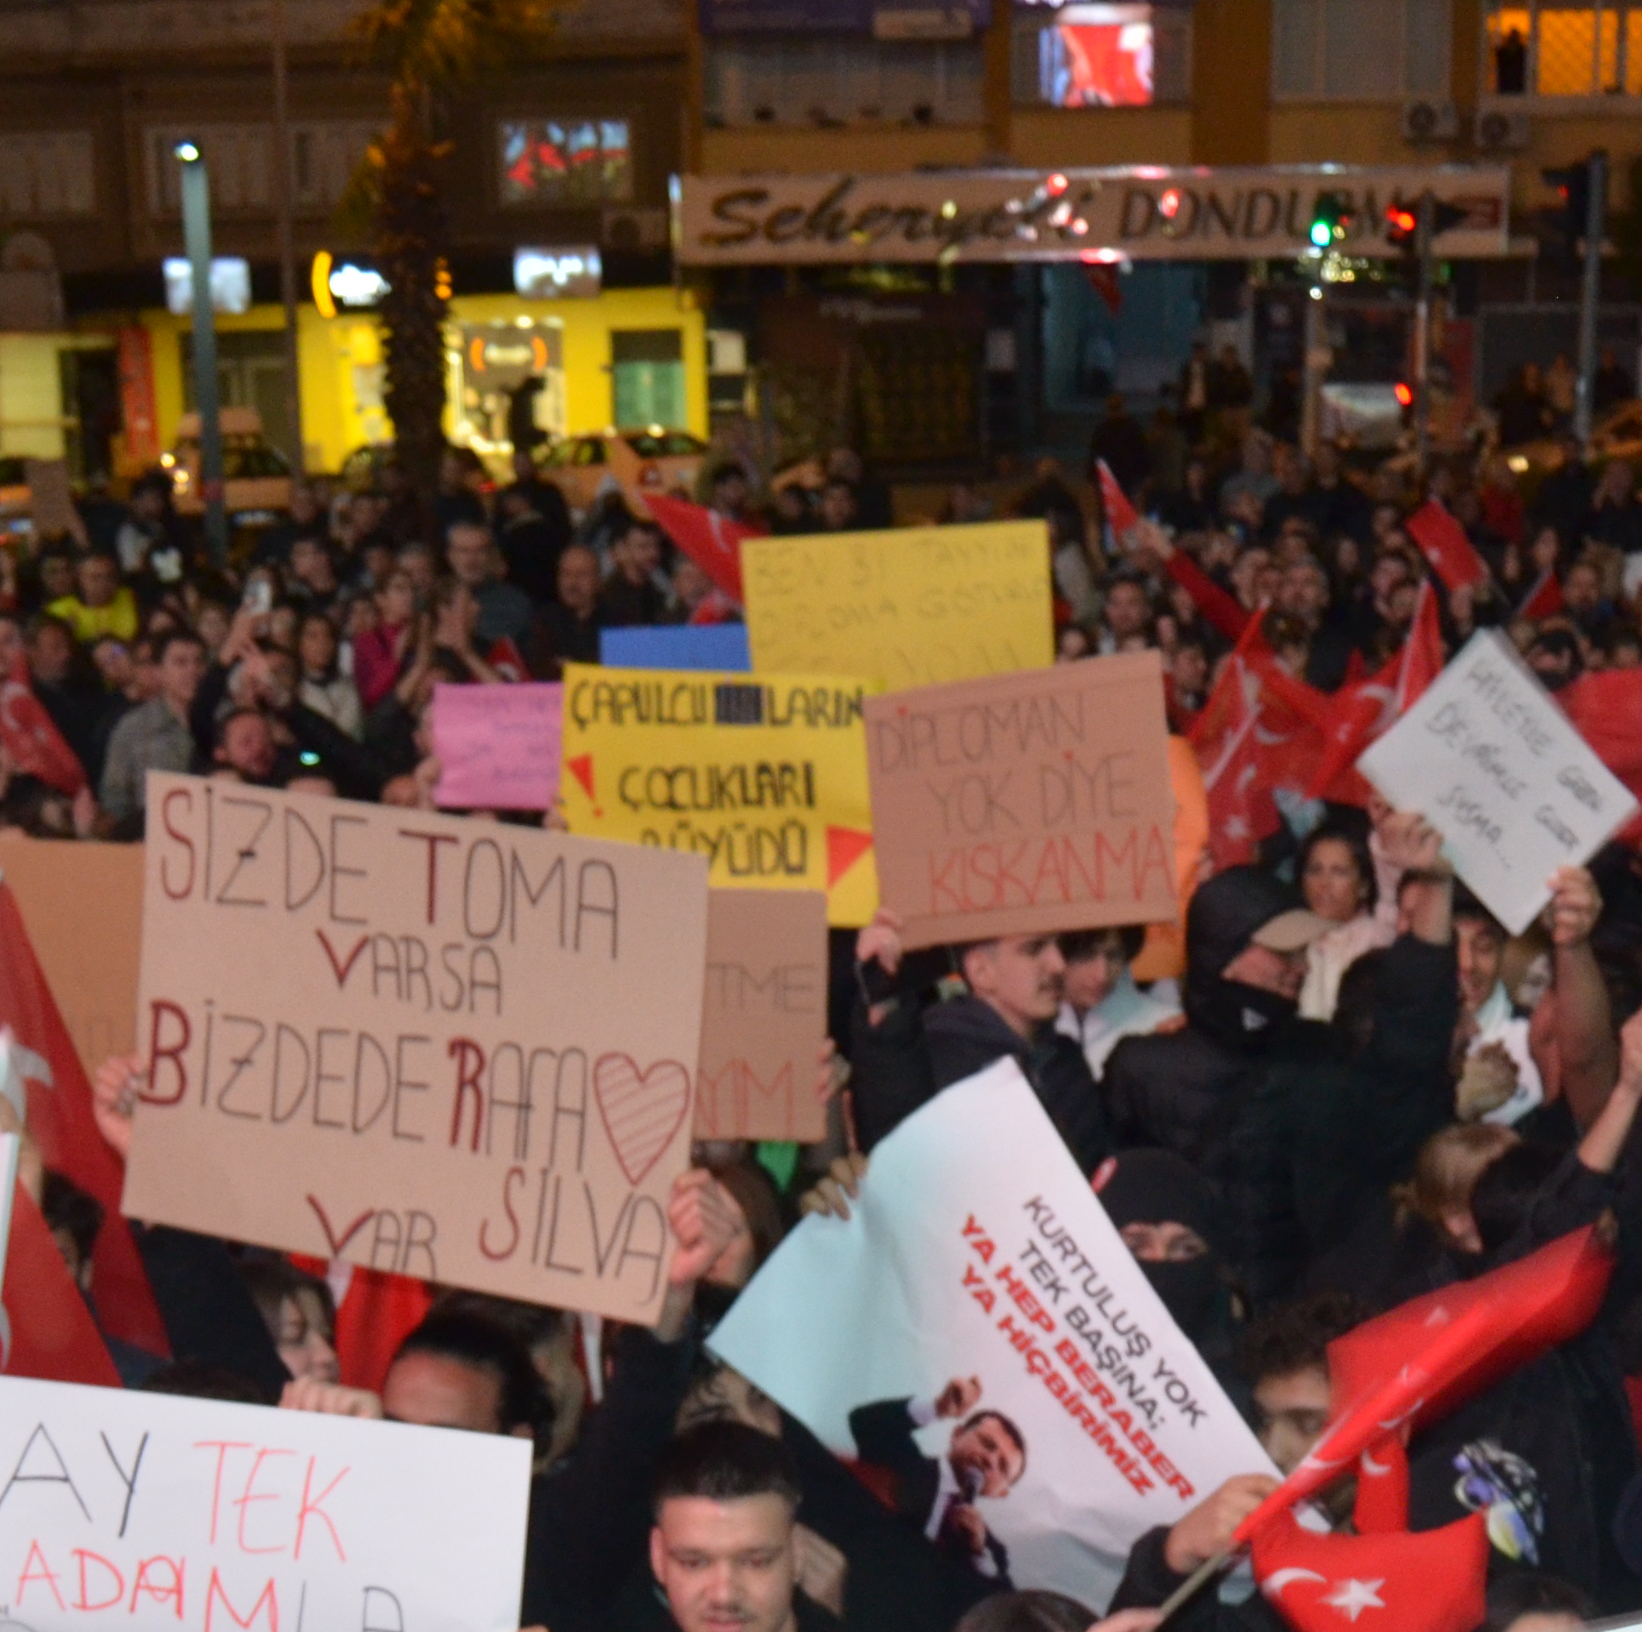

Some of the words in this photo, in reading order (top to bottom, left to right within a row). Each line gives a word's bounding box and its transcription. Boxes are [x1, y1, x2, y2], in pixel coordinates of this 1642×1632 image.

[618, 762, 815, 811] ÇOCUKLARI
[926, 771, 1020, 836] YOK
[1039, 750, 1138, 827] DİYE
[161, 786, 370, 924] SİZDE
[399, 828, 621, 960] TOMA
[930, 824, 1178, 916] KISKANMA
[315, 929, 504, 1017] VARSA
[308, 1194, 440, 1281] VAR
[1018, 1242, 1073, 1305] TEK
[959, 1212, 997, 1266] YA
[996, 1263, 1056, 1340] HEP
[1054, 1338, 1197, 1501] BERABER
[1022, 1194, 1152, 1359] KURTULUŞ
[1151, 1356, 1209, 1430] YOK
[959, 1267, 997, 1316] YA
[997, 1313, 1157, 1497] HİÇBİRİMİZ
[193, 1439, 354, 1563] TEK
